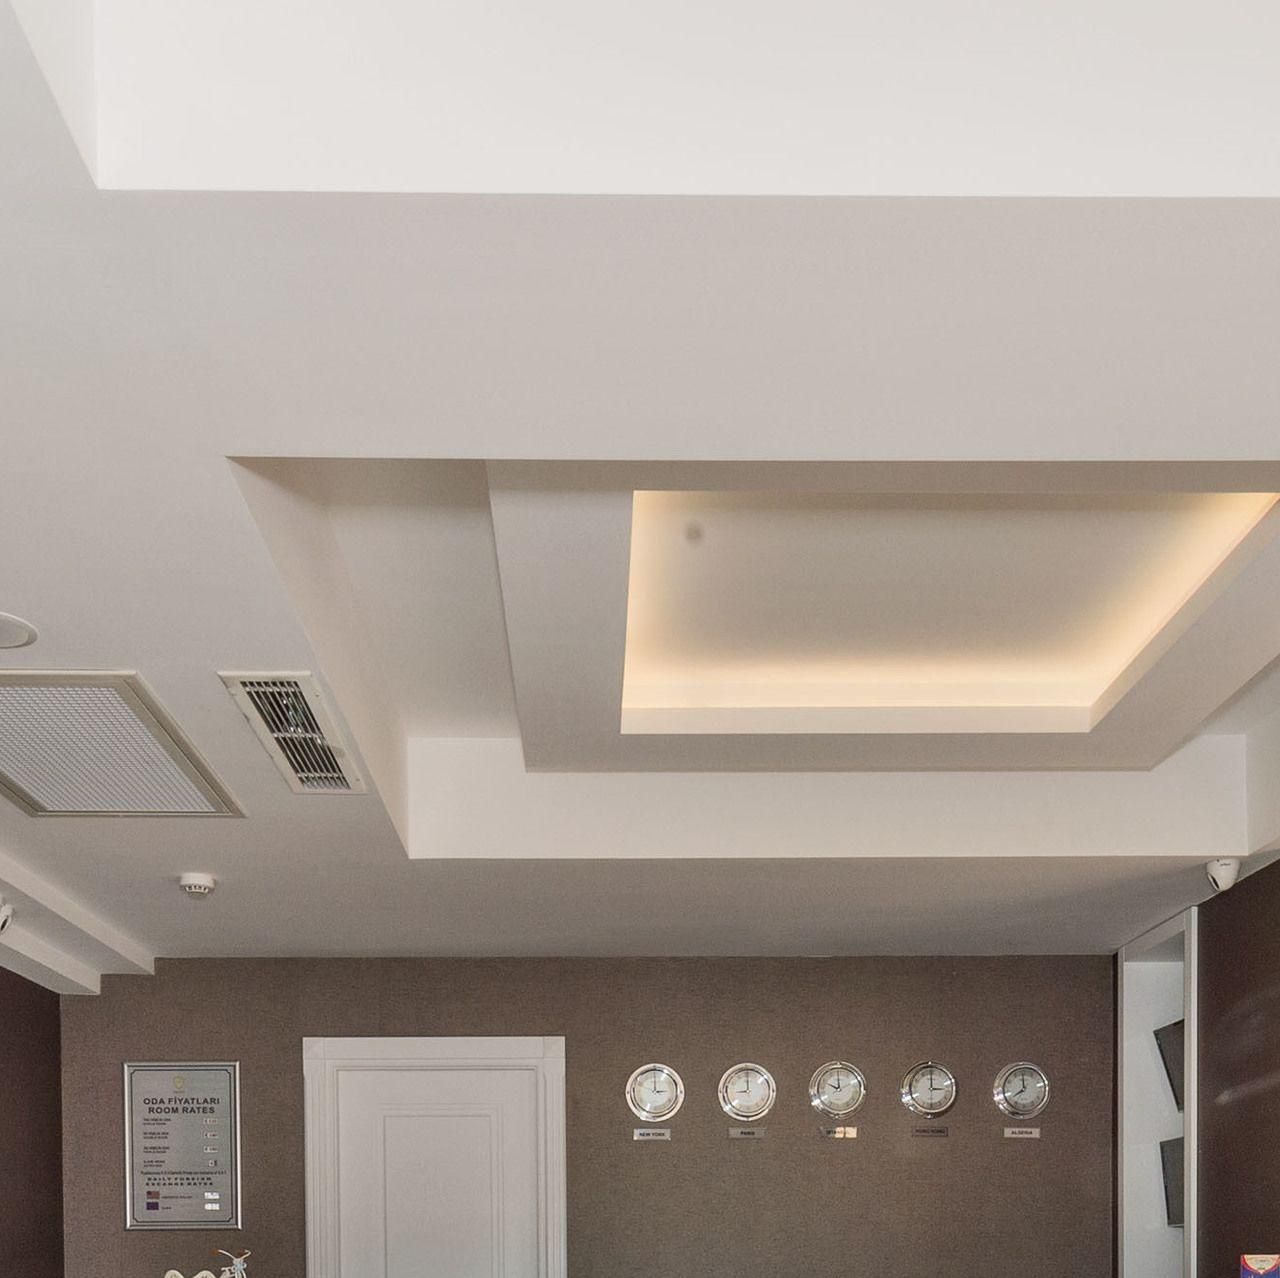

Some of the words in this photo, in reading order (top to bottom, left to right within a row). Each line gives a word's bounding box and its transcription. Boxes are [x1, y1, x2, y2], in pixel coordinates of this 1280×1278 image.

[168, 1096, 220, 1105] FİYATLARI
[148, 1106, 179, 1114] ROOM
[182, 1106, 215, 1114] RATES
